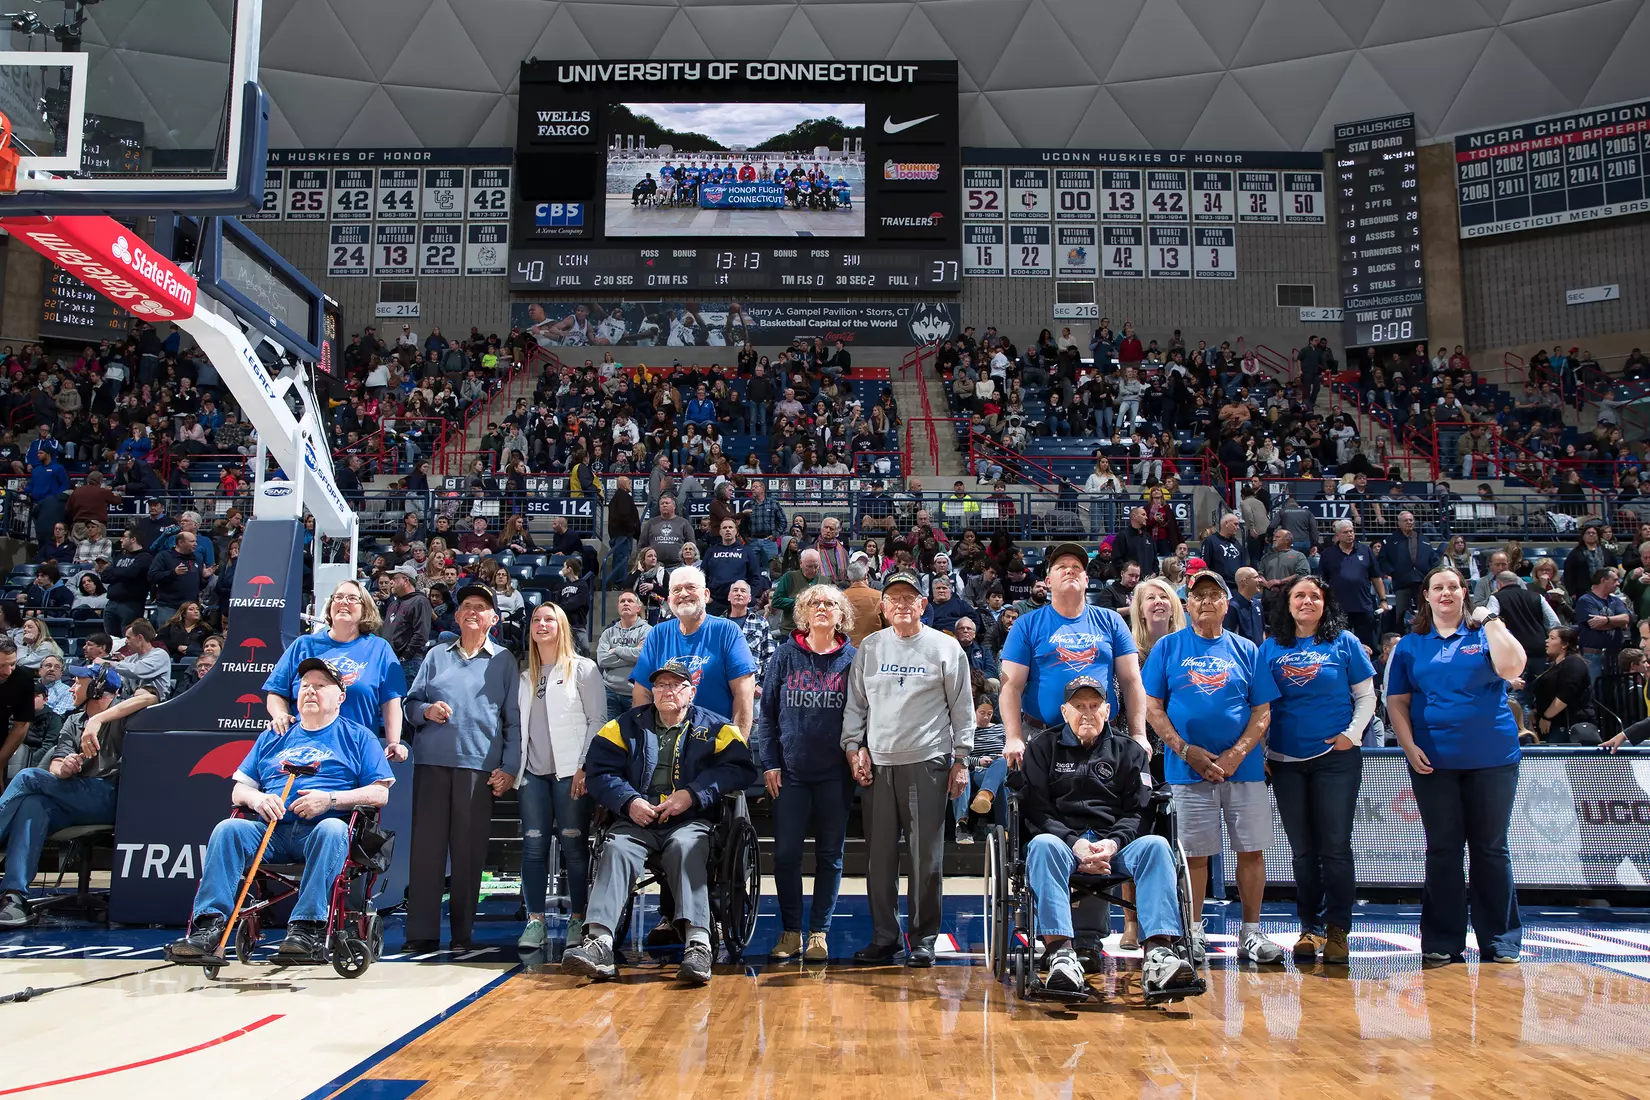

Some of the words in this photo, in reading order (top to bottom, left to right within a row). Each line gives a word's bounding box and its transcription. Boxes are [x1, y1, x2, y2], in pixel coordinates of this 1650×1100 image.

[558, 63, 700, 83] UNIVERSITY
[708, 62, 739, 80] OF
[746, 62, 919, 83] CONNECTICUT
[537, 111, 591, 122] WELLS
[537, 125, 590, 136] FARGO
[1338, 127, 1354, 137] GO
[1357, 118, 1411, 134] HUSKIES
[1348, 141, 1369, 153] STAT
[1371, 136, 1403, 149] BOARD
[1470, 128, 1524, 147] NCAA
[1469, 134, 1574, 159] TOURNAMENT
[288, 152, 350, 160] HUSKIES
[358, 152, 375, 160] OF
[383, 152, 432, 160] HONOR
[1042, 152, 1091, 161] UCONN
[1099, 153, 1161, 162] HUSKIES
[1170, 154, 1186, 162] OF
[1195, 154, 1243, 163] HONOR
[1461, 161, 1488, 180] 2000
[1496, 156, 1524, 173] 2002
[1532, 149, 1561, 167] 2003
[1568, 143, 1598, 161] 2004
[1606, 136, 1636, 155] 2005
[899, 163, 940, 172] DUNKIN'
[1368, 168, 1385, 177] FG%
[1404, 164, 1415, 172] 34
[899, 171, 940, 180] DONUTS
[1462, 183, 1489, 201] 2009
[1498, 177, 1525, 195] 2011
[1534, 172, 1560, 190] 2012
[1570, 165, 1599, 184] 2014
[1607, 159, 1636, 178] 2016
[728, 186, 756, 194] HONOR
[1369, 184, 1385, 193] FT%
[1401, 179, 1416, 188] 100
[291, 191, 323, 211] 25
[337, 190, 369, 210] 42
[382, 190, 414, 210] 44
[473, 190, 506, 210] 42
[968, 190, 999, 210] 52
[1060, 191, 1091, 211] 00
[1109, 191, 1135, 211] 13
[1152, 192, 1183, 212] 42
[1204, 193, 1222, 213] 34
[1250, 193, 1267, 213] 32
[1294, 194, 1314, 213] 50
[1365, 201, 1370, 209] 3
[1372, 200, 1381, 208] PT
[1382, 199, 1392, 207] FG
[535, 203, 580, 217] CBS
[881, 217, 933, 226] TRAVELERS
[1360, 214, 1399, 226] REBOUNDS
[1468, 214, 1563, 236] CONNECTICUT
[1570, 206, 1612, 221] MEN'S
[1365, 230, 1396, 242] ASSISTS
[333, 246, 365, 267] 24
[383, 246, 408, 266] 13
[426, 246, 456, 266] 22
[976, 246, 992, 266] 15
[1021, 247, 1039, 266] 22
[1113, 247, 1132, 268] 42
[1159, 247, 1179, 268] 13
[1210, 248, 1219, 268] 3
[1360, 246, 1402, 258] TURNOVERS
[715, 252, 760, 269] 13:13
[517, 260, 544, 282] 40
[932, 260, 958, 282] 37
[1367, 263, 1396, 274] BLOCKS
[561, 276, 581, 285] FULL
[594, 275, 601, 286] 2
[603, 276, 614, 285] 30
[616, 276, 633, 285] SEC
[657, 276, 670, 285] TM
[672, 276, 688, 285] FLS
[782, 275, 795, 285] TM
[797, 275, 812, 285] FLS
[836, 276, 847, 285] 30
[849, 276, 866, 285] SEC
[868, 275, 875, 286] 2
[888, 276, 909, 285] FULL
[1369, 280, 1396, 290] STEALS
[1567, 292, 1585, 301] SEC
[1603, 287, 1612, 298] 7
[396, 305, 419, 315] 214
[748, 308, 774, 317] Harry
[775, 308, 784, 316] A.
[786, 307, 821, 317] Gampel
[823, 307, 857, 316] Pavilion
[866, 308, 894, 317] Storrs,
[896, 308, 909, 316] CT
[1075, 306, 1098, 316] 216
[1300, 310, 1316, 318] SEC
[1322, 309, 1343, 319] 217
[1356, 310, 1378, 322] TIME
[1380, 309, 1393, 320] OF
[1395, 307, 1413, 318] DAY
[760, 319, 806, 327] Basketball
[808, 319, 840, 328] Capital
[841, 319, 852, 327] of
[853, 319, 868, 327] the
[870, 319, 897, 327] World
[1371, 321, 1412, 342] 8:08
[243, 347, 276, 399] LEGACY
[317, 468, 346, 513] SPORTS
[527, 502, 550, 512] SEC
[560, 500, 592, 515] 114
[1319, 504, 1350, 518] 117
[713, 551, 742, 559] UCONN
[228, 598, 286, 608] TRAVELERS
[880, 663, 926, 674] UConn
[1181, 656, 1206, 667] Honor
[787, 670, 847, 692] UCONN
[786, 689, 845, 709] HUSKIES
